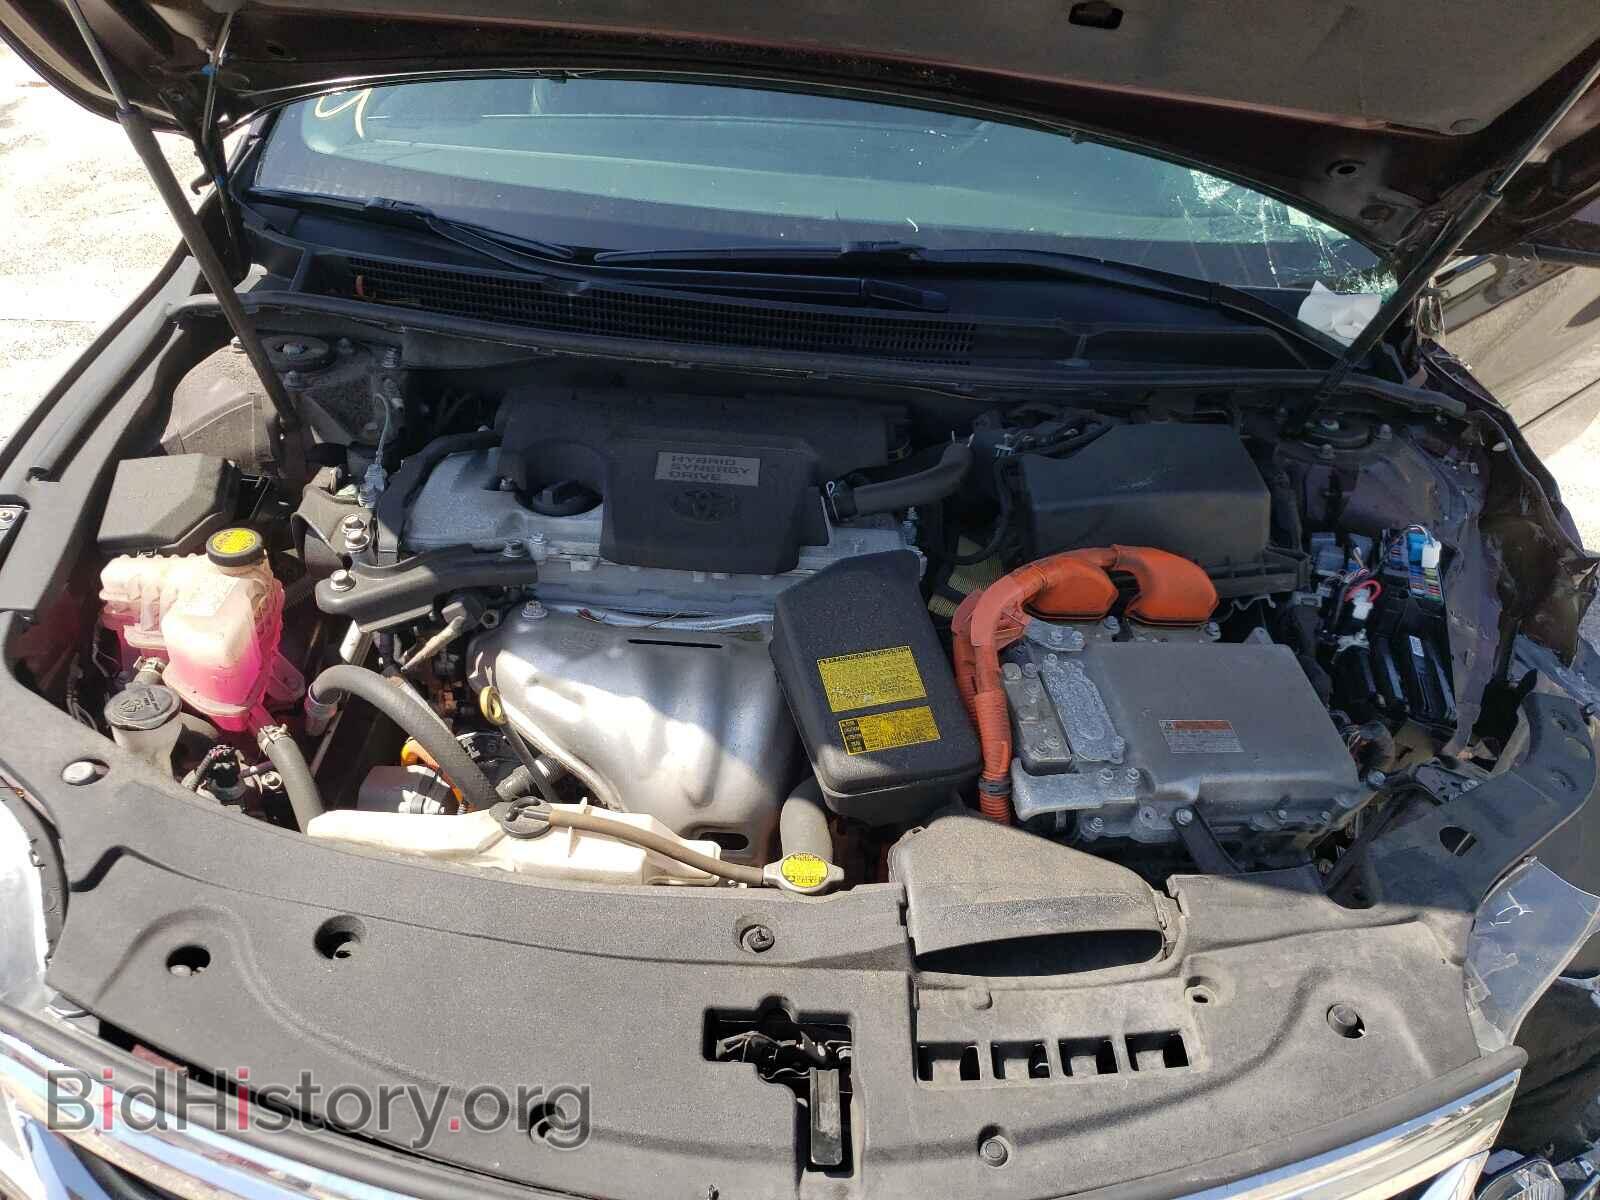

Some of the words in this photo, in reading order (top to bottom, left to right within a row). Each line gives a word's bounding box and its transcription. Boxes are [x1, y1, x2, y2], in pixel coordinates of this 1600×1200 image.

[671, 455, 736, 465] HYBRID
[670, 464, 750, 474] SYNERGY
[669, 472, 721, 481] DRIVE
